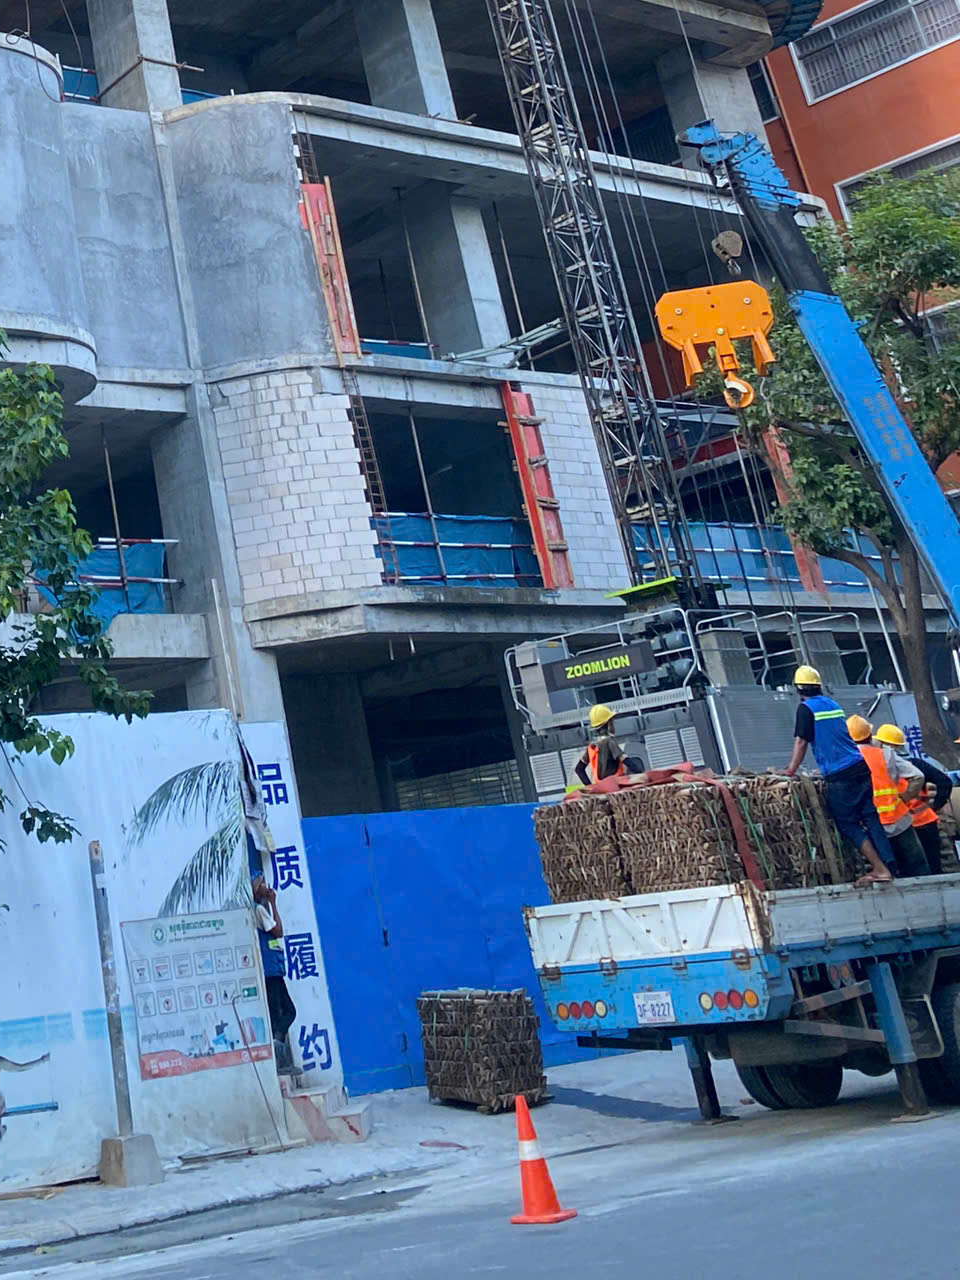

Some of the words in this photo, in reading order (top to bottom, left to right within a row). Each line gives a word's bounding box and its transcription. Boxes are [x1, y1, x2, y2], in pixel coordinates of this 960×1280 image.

[565, 654, 630, 679] ZOOMLION
[257, 763, 333, 1071] 品质履约
[637, 1002, 670, 1017] 3F-8227
